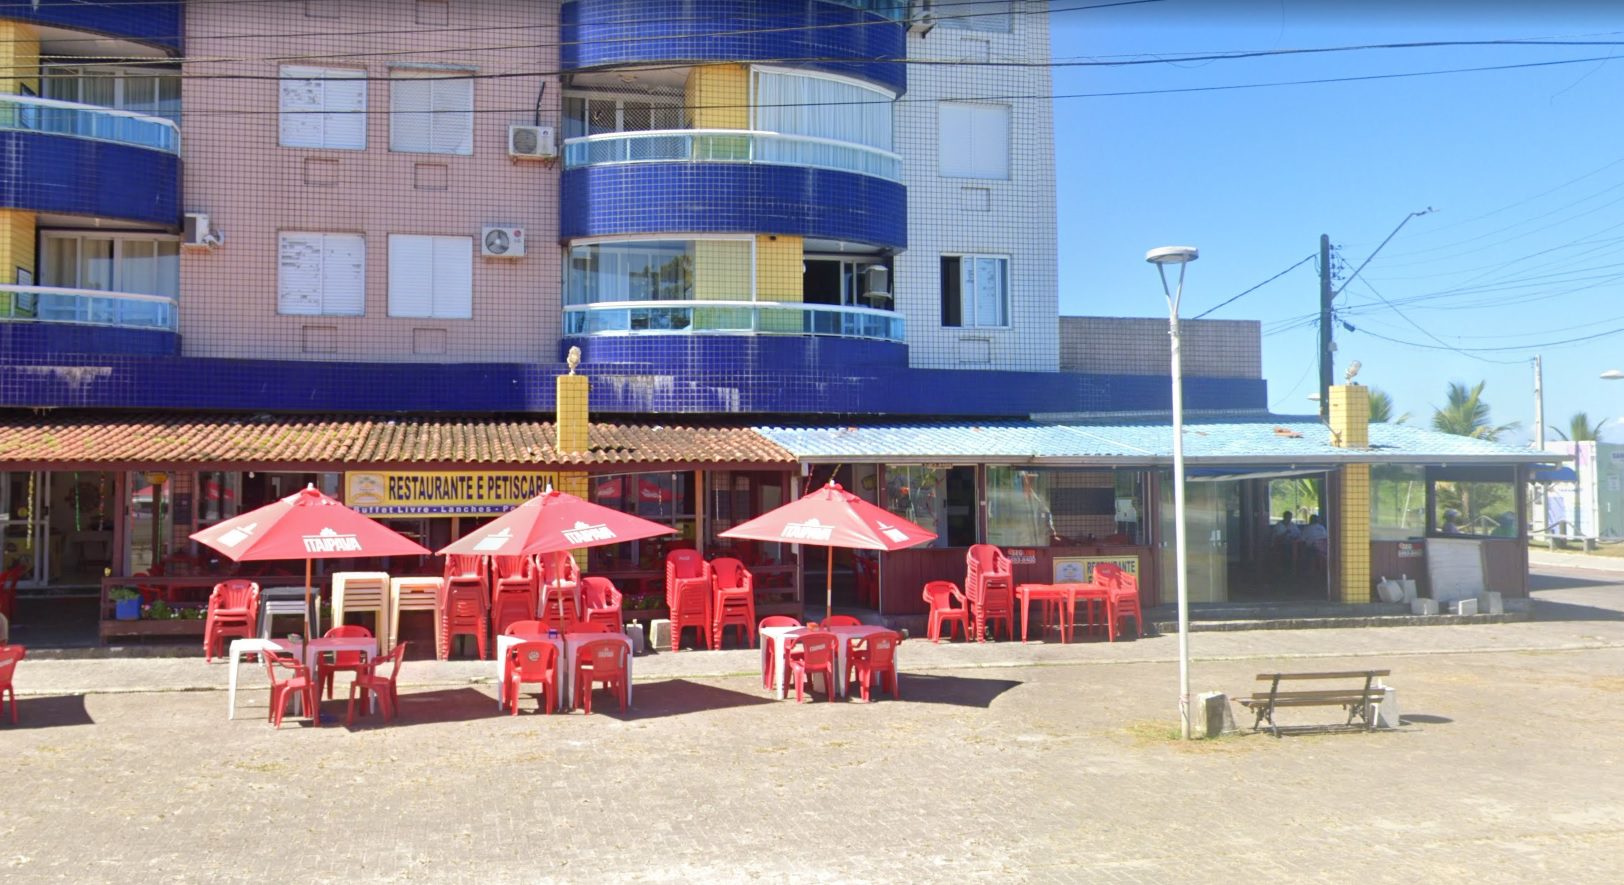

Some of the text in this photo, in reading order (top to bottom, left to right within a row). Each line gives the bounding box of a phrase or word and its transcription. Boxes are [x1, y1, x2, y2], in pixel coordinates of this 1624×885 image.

[389, 475, 554, 500] RESTAURANTE E PETISCARIA
[397, 505, 429, 514] Livre
[440, 505, 492, 514] Lanches
[303, 537, 362, 552] ITAIPAVA
